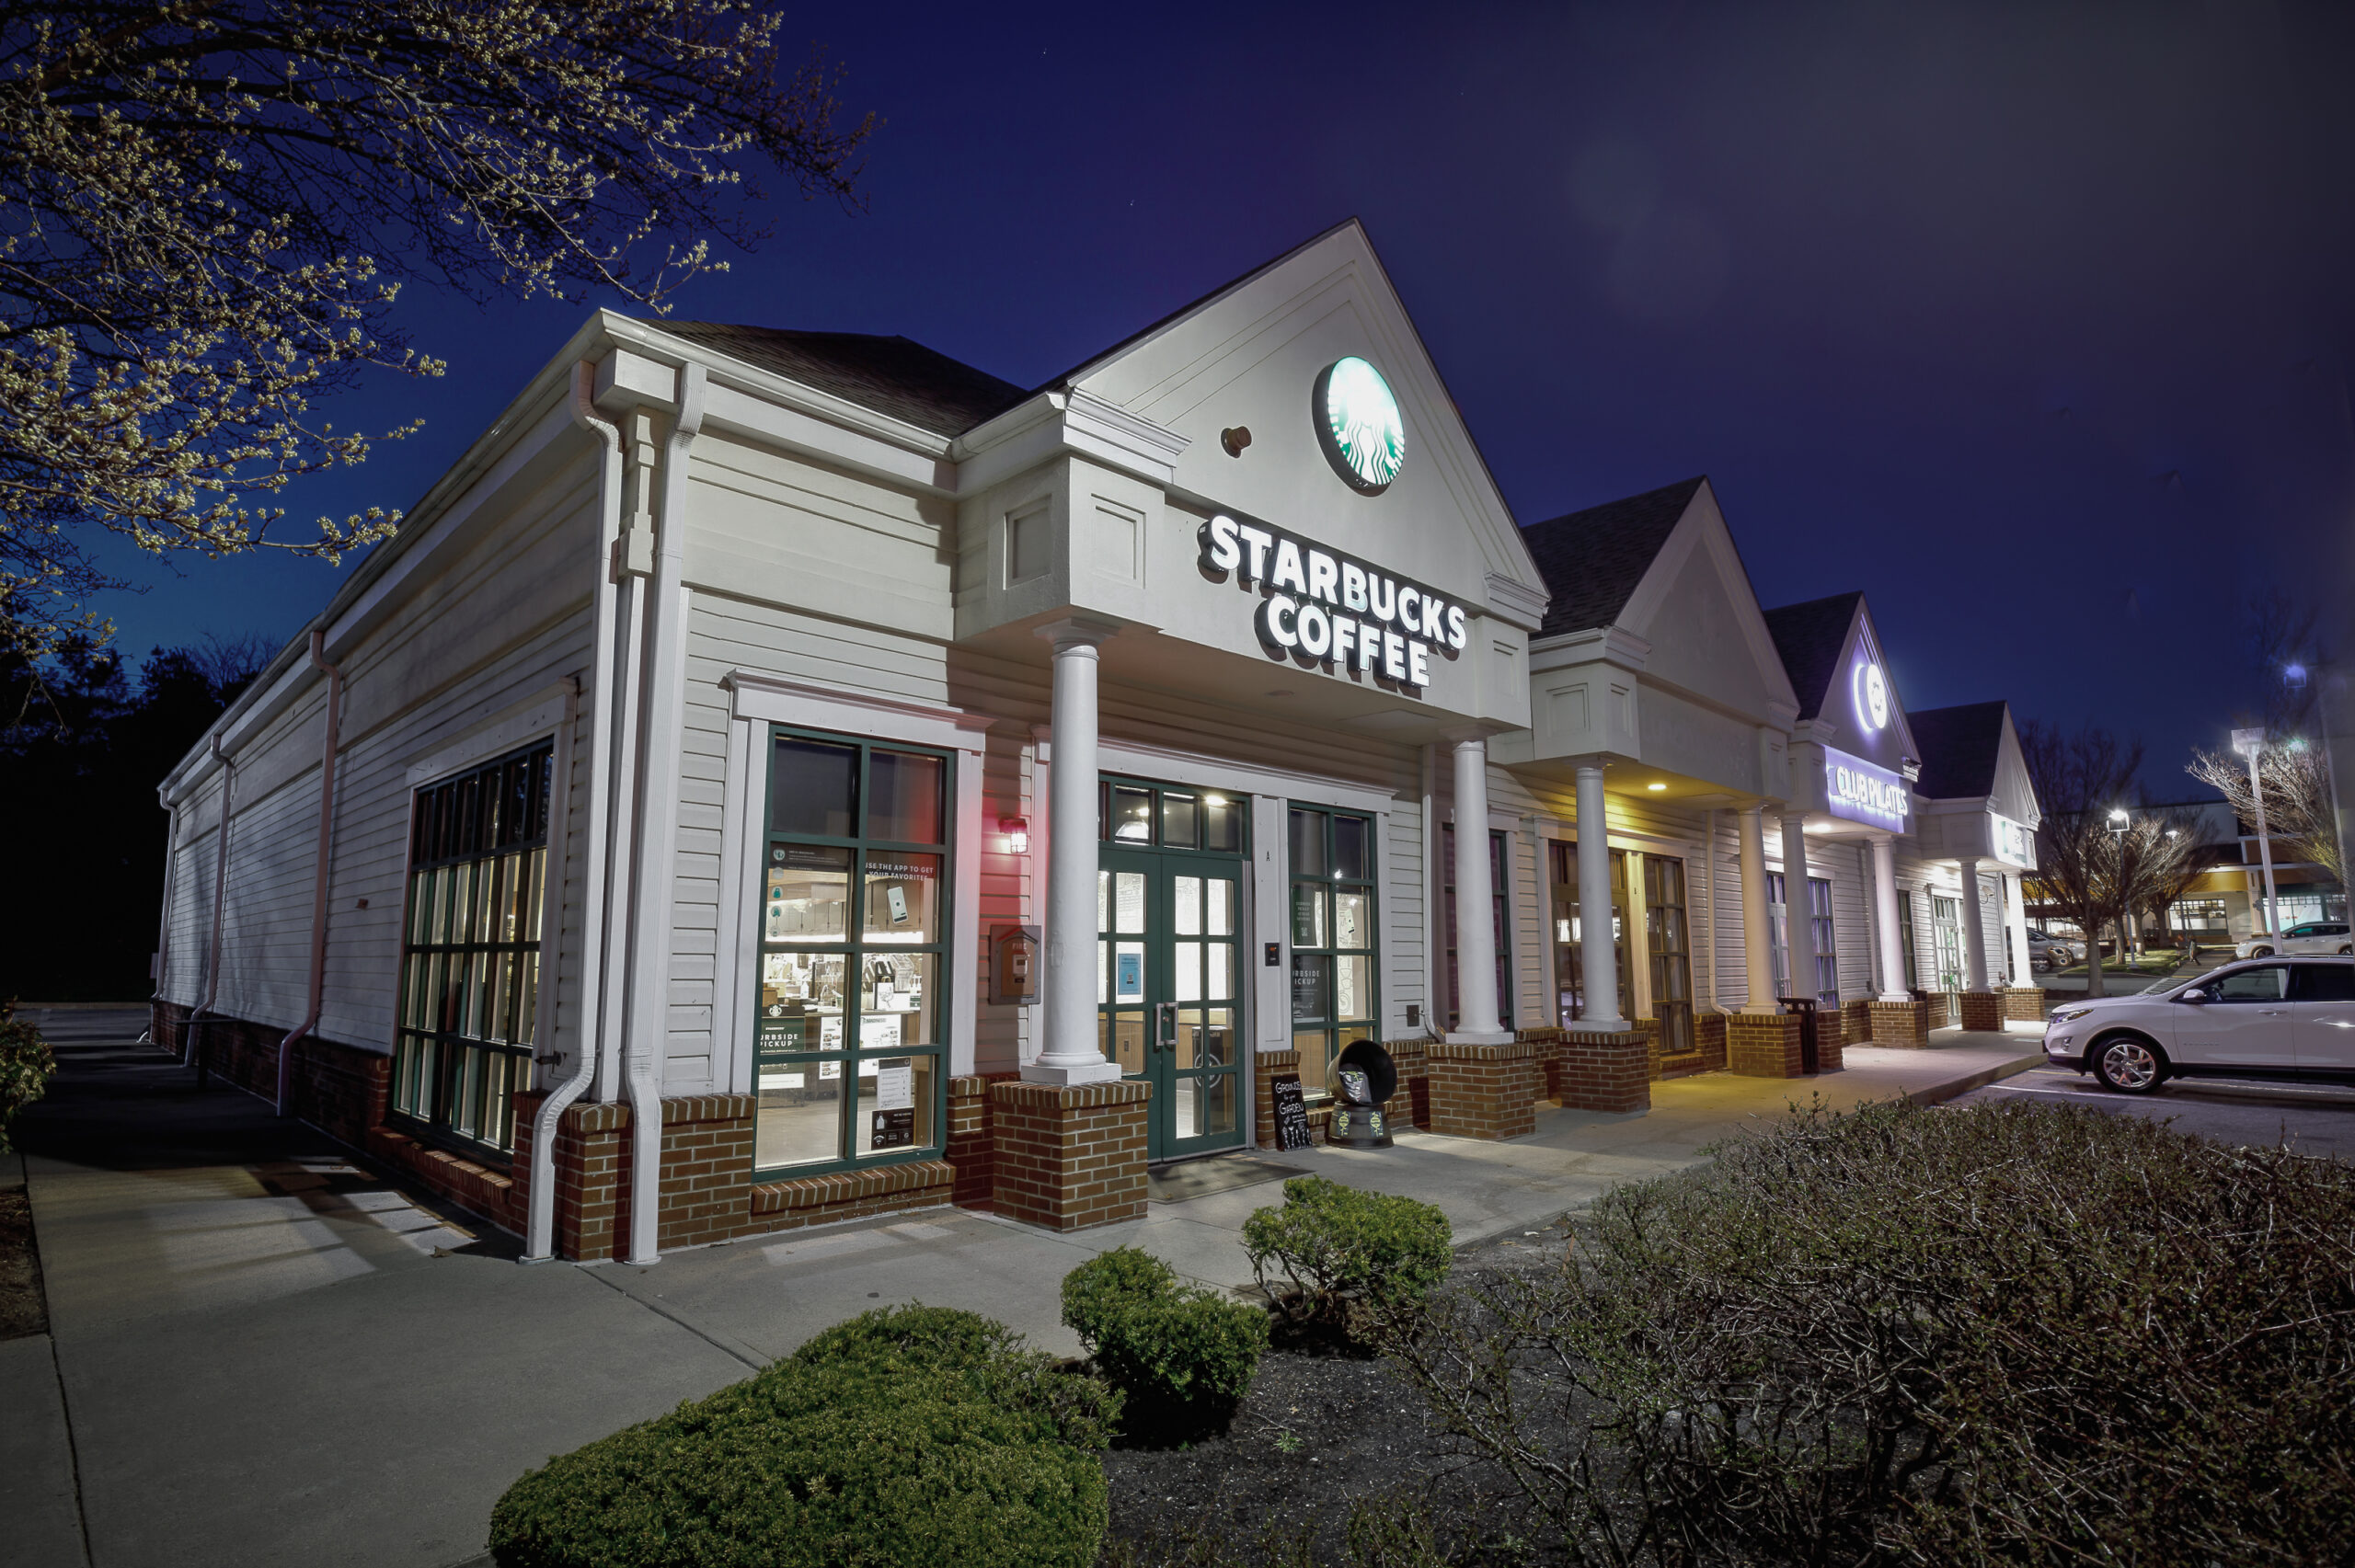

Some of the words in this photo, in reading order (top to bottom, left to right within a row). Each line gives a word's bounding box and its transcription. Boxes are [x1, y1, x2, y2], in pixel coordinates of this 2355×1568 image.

[1209, 514, 1467, 650] STARBUCKS
[1266, 594, 1430, 688] COFFEE
[1836, 766, 1868, 804] CLUB
[1867, 776, 1908, 817] PILATES
[879, 863, 892, 871] THE
